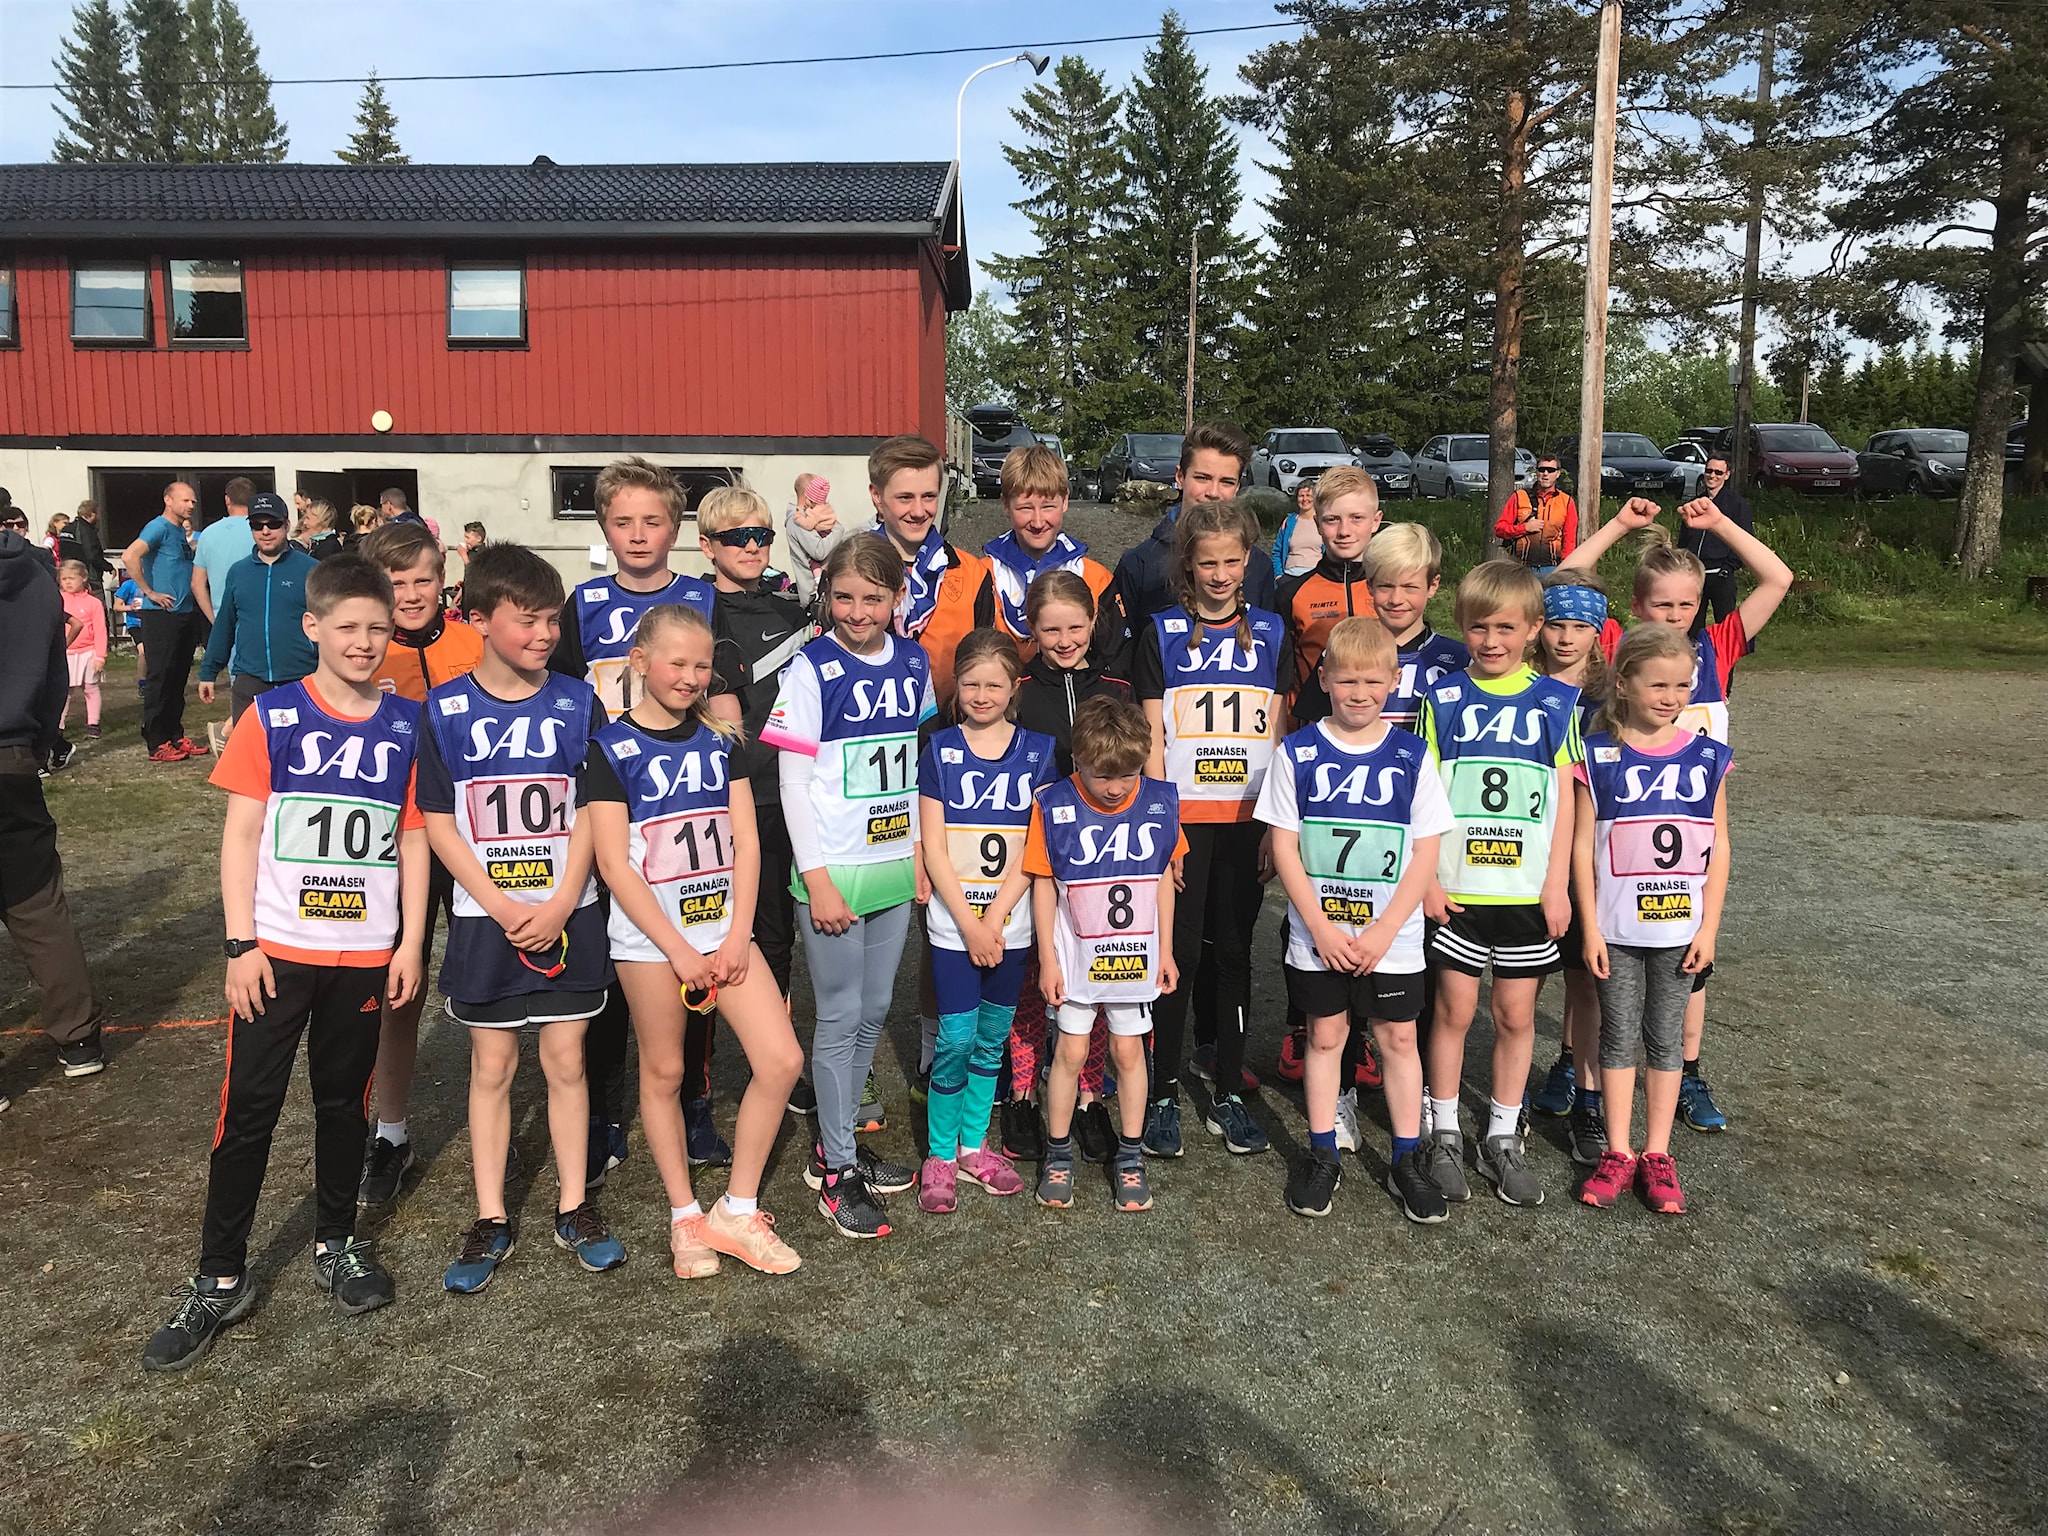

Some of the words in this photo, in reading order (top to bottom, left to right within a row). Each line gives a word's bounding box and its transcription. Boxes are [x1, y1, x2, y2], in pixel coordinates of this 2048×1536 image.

[1309, 601, 1339, 609] TRIMTEX
[1177, 637, 1266, 673] SAS
[843, 677, 919, 722] SAS
[1254, 709, 1267, 734] 3
[1453, 703, 1549, 746] SAS
[463, 716, 566, 762] SAS
[1196, 746, 1248, 757] GRANÅSEN
[287, 731, 401, 783] SAS
[1198, 760, 1245, 774] GLAVA
[641, 750, 729, 802] SAS
[949, 770, 1033, 812] SAS
[1199, 774, 1244, 783] ISOLASJON
[1308, 762, 1405, 806] SAS
[1615, 764, 1709, 804] SAS
[1481, 767, 1509, 813] 8
[1529, 791, 1541, 819] 2
[486, 783, 550, 835] 10
[553, 802, 566, 832] 1
[871, 814, 909, 834] GLAVA
[307, 806, 371, 860] 10
[378, 833, 398, 861] 2
[1069, 822, 1161, 866] SAS
[1467, 826, 1523, 838] GRANÅSEN
[486, 844, 551, 858] GRANÅSEN
[980, 833, 1007, 878] 9
[1332, 829, 1361, 874] 7
[1381, 850, 1397, 878] 2
[1470, 840, 1518, 857] GLAVA
[1652, 823, 1683, 870] 9
[1700, 846, 1711, 873] 1
[302, 875, 366, 888] GRANÅSEN
[490, 861, 549, 878] GLAVA
[303, 891, 365, 908] GLAVA
[305, 908, 363, 919] ISOLASJON
[1107, 883, 1134, 930] 8
[1640, 894, 1692, 910] GLAVA
[1642, 910, 1691, 921] ISOLASJON
[1092, 956, 1145, 971] GLAVA
[1093, 972, 1143, 981] ISOLASJON
